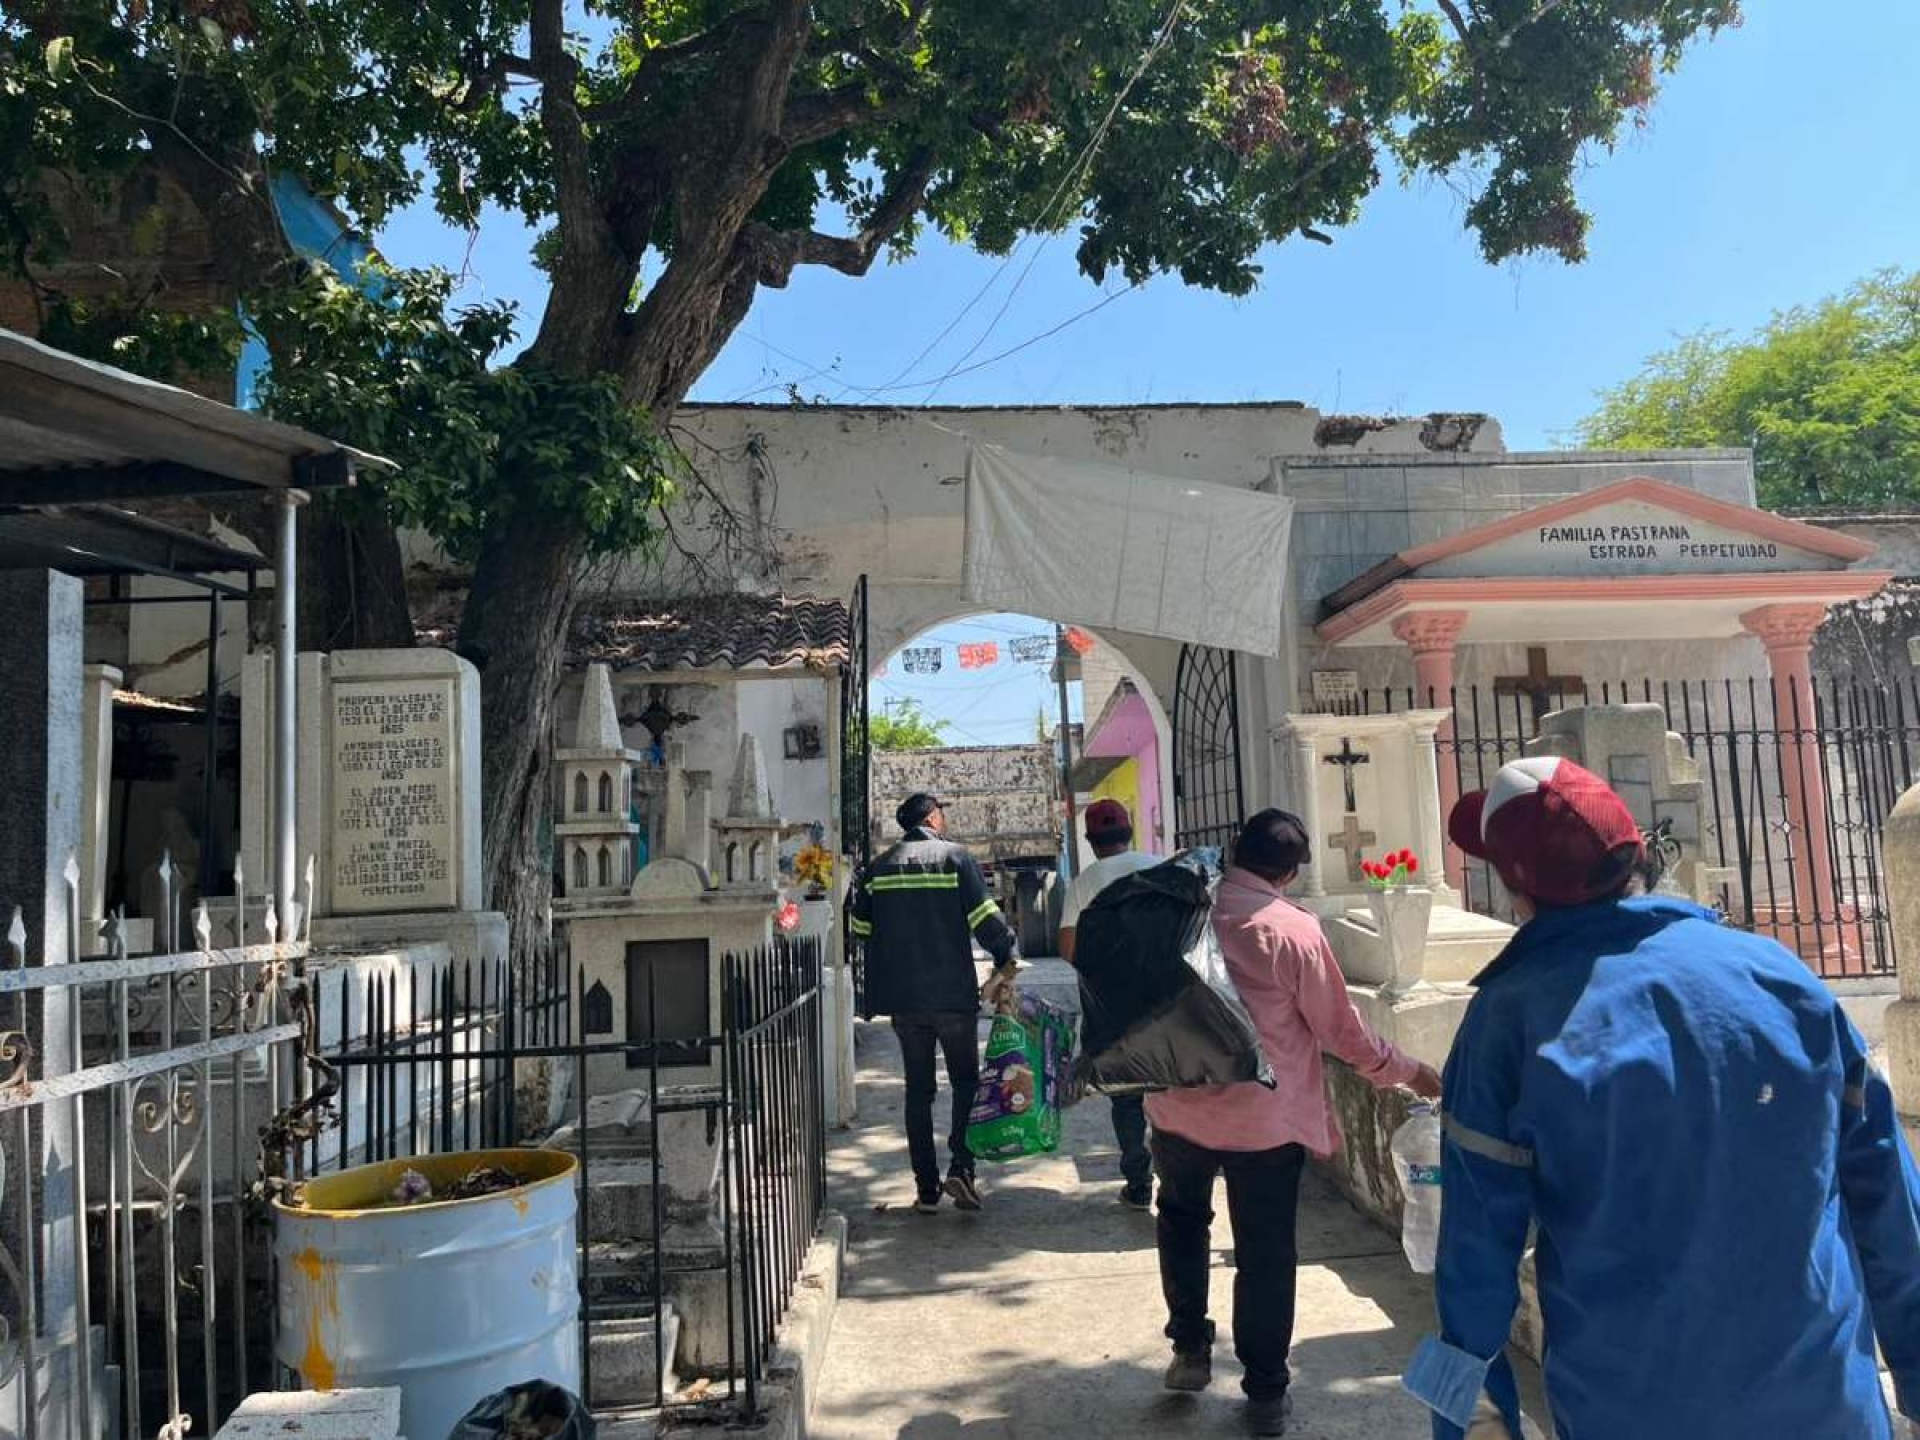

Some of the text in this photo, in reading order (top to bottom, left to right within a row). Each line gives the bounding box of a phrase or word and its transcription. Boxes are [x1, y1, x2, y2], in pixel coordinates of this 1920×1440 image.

[1540, 525, 1691, 543] FAMILIA PASTRANA
[1589, 543, 1777, 559] ESTRADA PERPETUIDAD
